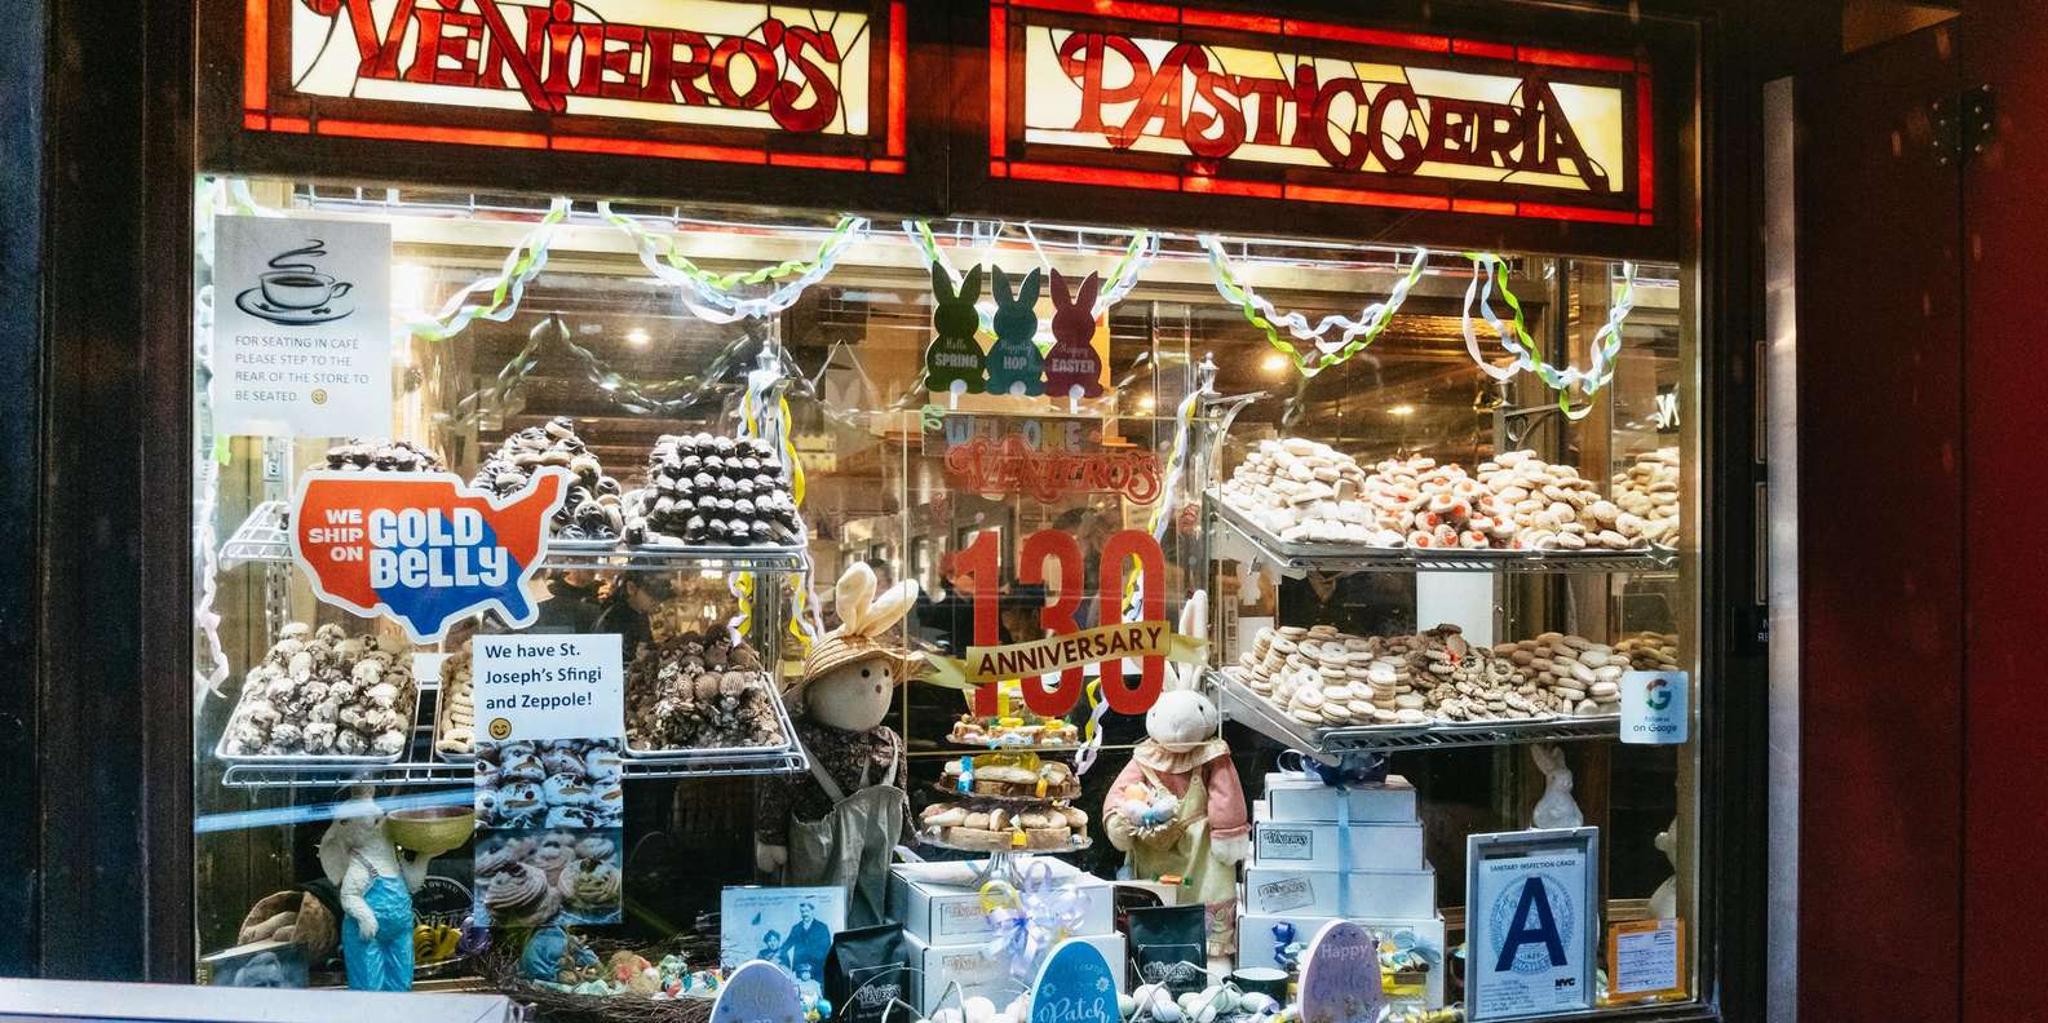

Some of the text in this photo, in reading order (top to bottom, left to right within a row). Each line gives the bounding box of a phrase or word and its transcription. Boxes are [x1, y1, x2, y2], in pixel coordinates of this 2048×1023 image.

[235, 336, 258, 347] FOR
[262, 336, 311, 348] SEATING
[315, 337, 327, 348] IN
[235, 353, 352, 367] PLEASE STEP TO THE
[935, 353, 977, 368] SPRING
[1004, 356, 1027, 370] HOP
[1052, 359, 1096, 373] EASTER
[235, 371, 369, 384] REAR OF THE STORE TO
[235, 390, 250, 401] BE
[326, 509, 363, 524] WE
[308, 527, 364, 544] SHIP
[368, 508, 483, 548] GOLD
[330, 547, 363, 562] ON
[953, 529, 1166, 717] 130
[485, 642, 581, 659] We have St.
[978, 626, 1162, 677] ANNIVERSARY
[485, 667, 602, 685] Joseph's Sfingi
[486, 693, 593, 711] and Zeppole!
[1649, 723, 1678, 735] Google
[1490, 863, 1518, 872] SANITARY
[1521, 862, 1554, 870] INSPECTION
[1494, 876, 1568, 972] A
[1321, 943, 1368, 960] Happy
[1555, 978, 1575, 987] NYC
[1036, 997, 1110, 1023] Patch
